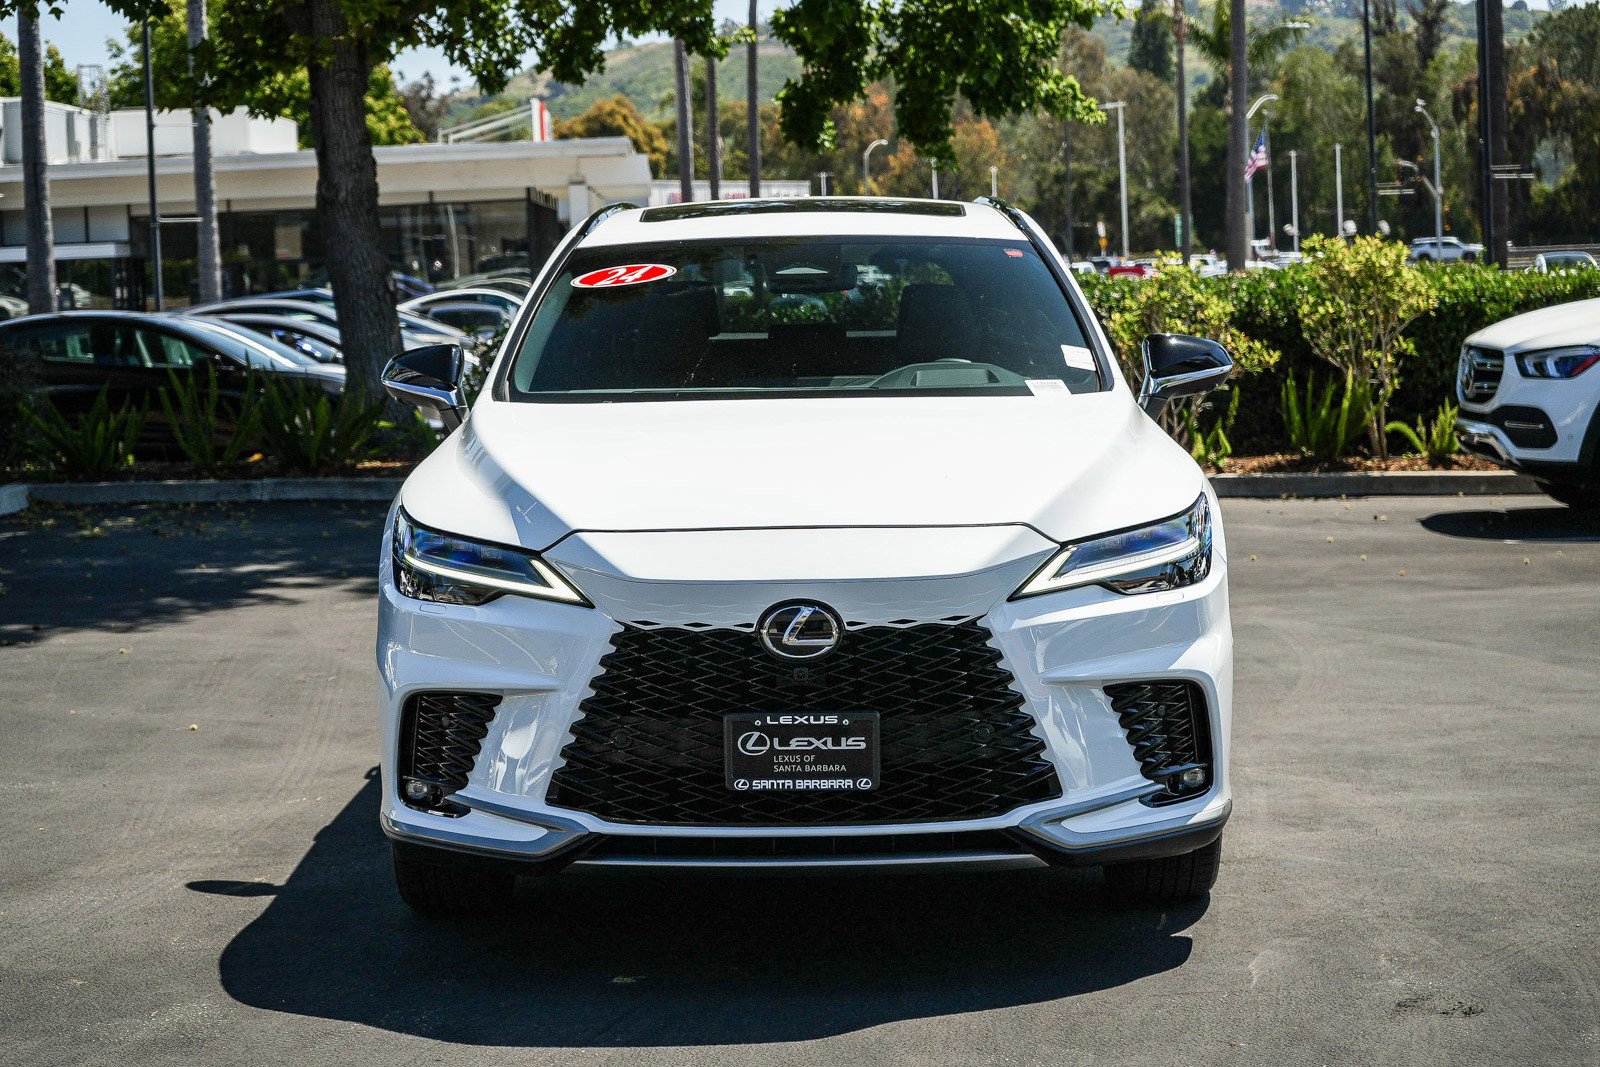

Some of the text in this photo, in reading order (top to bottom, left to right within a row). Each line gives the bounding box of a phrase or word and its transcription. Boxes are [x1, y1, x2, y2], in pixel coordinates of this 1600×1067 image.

[593, 265, 654, 285] 24
[767, 715, 838, 725] LEXUS
[773, 737, 867, 750] LEXUS
[773, 755, 816, 763] LEXUS OF
[804, 764, 847, 772] BARBARA
[752, 780, 793, 790] SANTA
[796, 779, 853, 789] BARBARA
